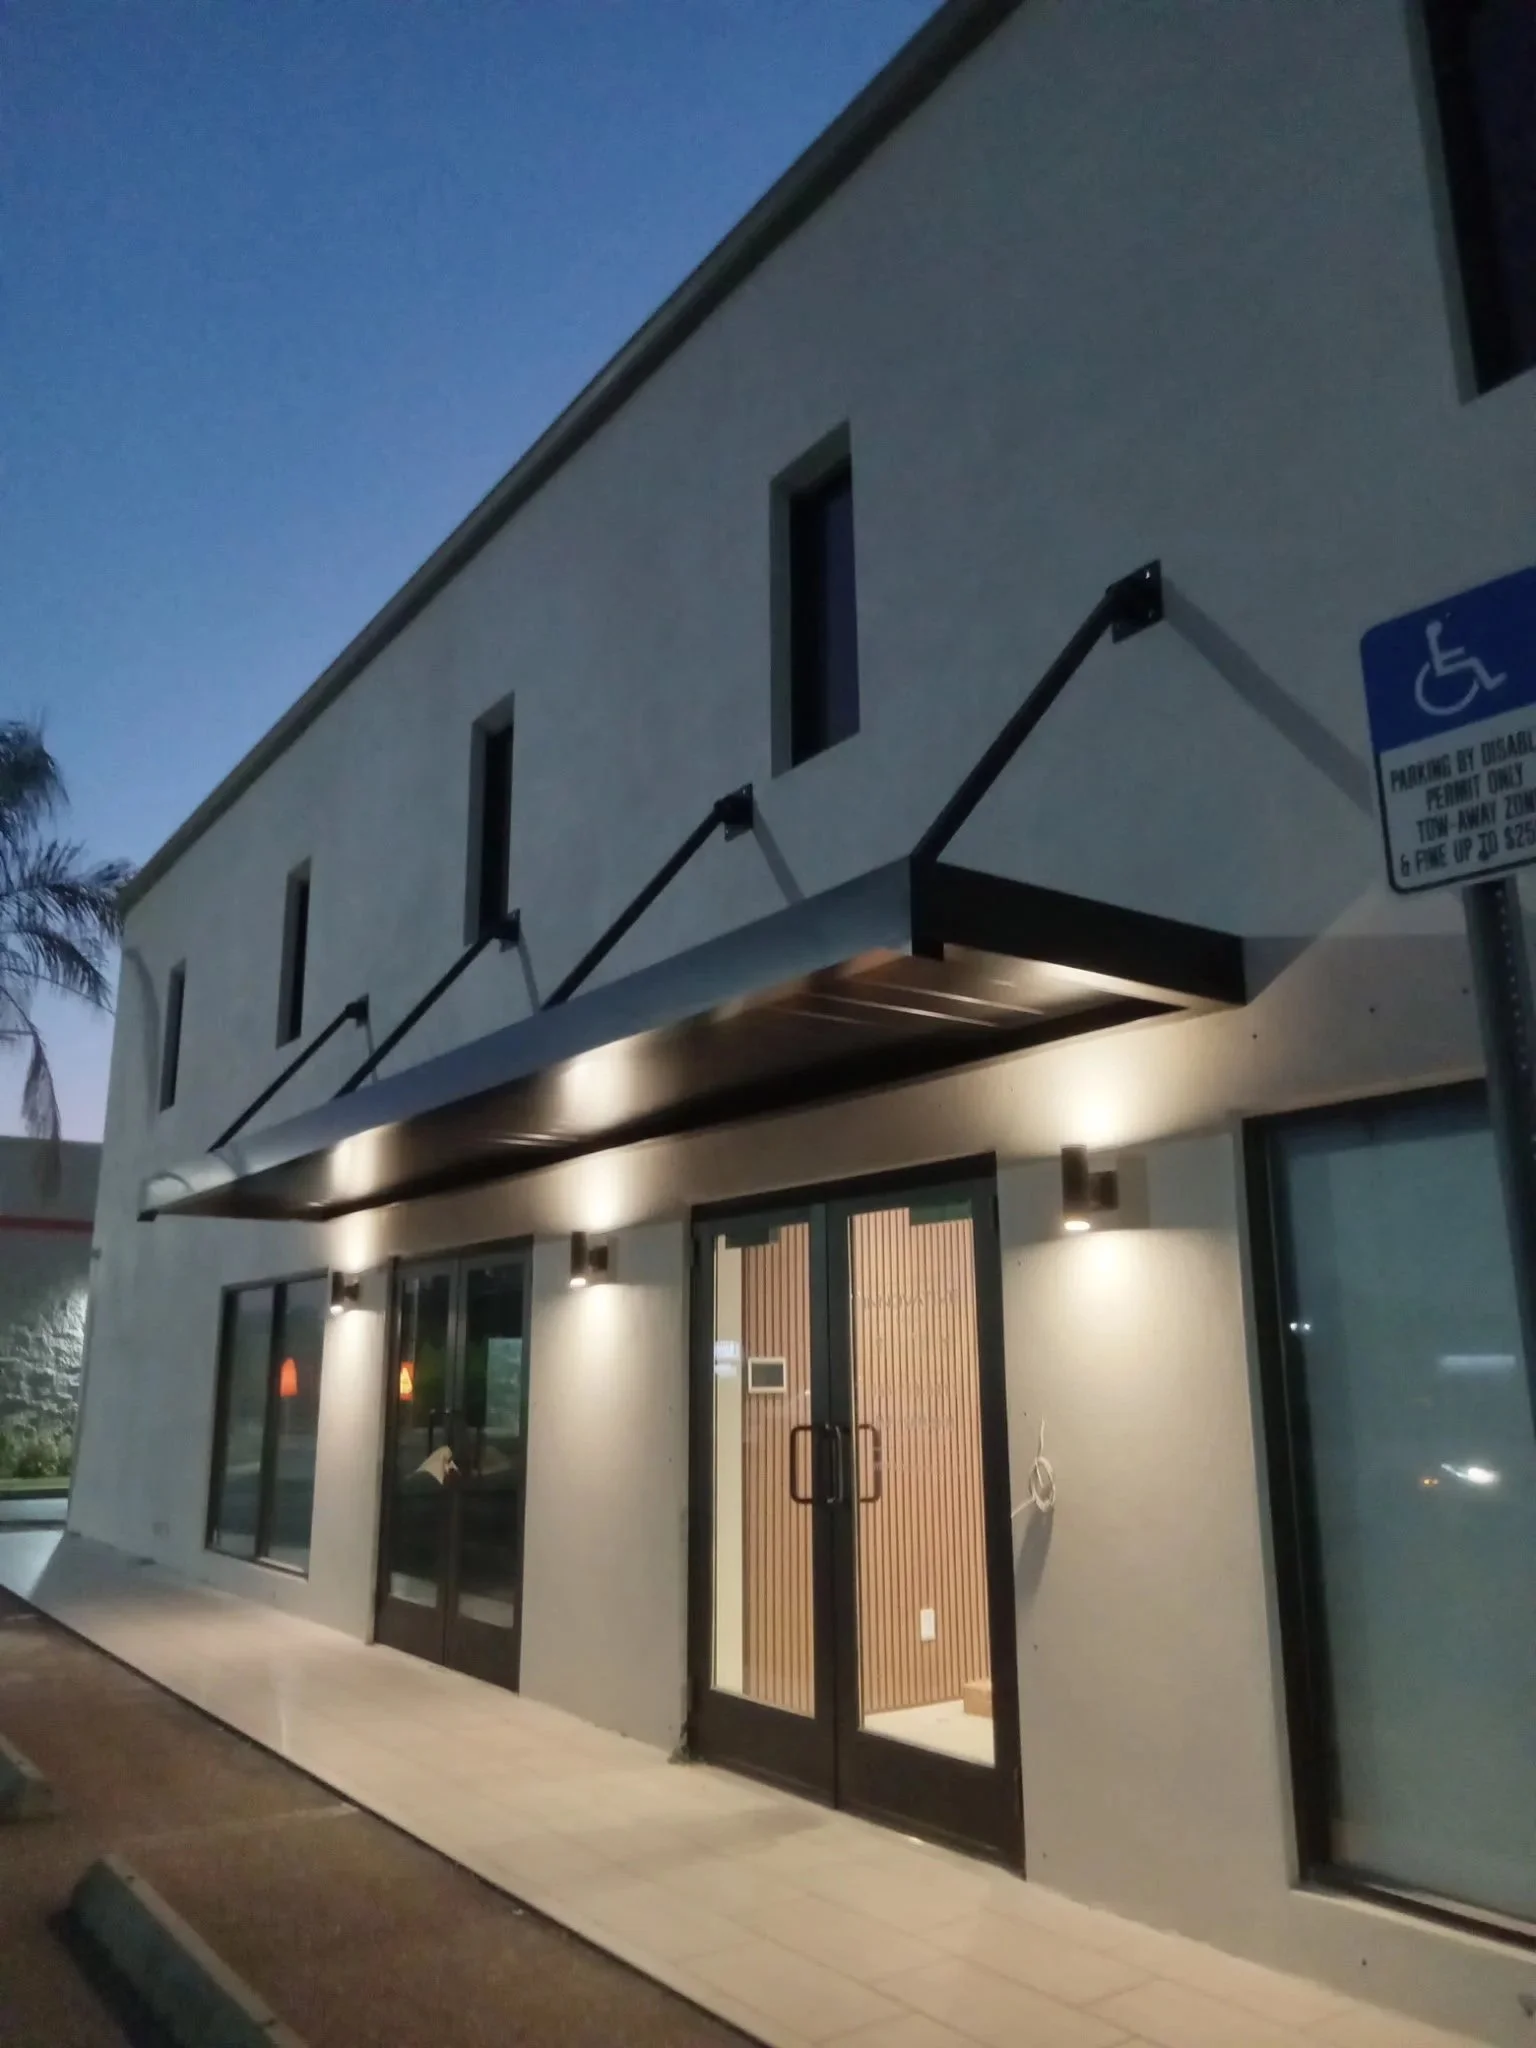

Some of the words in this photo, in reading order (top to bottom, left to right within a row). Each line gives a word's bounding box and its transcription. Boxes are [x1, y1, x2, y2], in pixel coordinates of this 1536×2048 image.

[1390, 753, 1451, 793] PARKING
[1456, 747, 1474, 774] BY
[1426, 773, 1480, 811] PERMIT
[1487, 761, 1523, 794] ONLY
[1504, 787, 1536, 820] ZON
[1400, 852, 1410, 877] &
[1415, 842, 1448, 875] FINE
[1453, 836, 1473, 864] UP
[1477, 829, 1499, 860] TO
